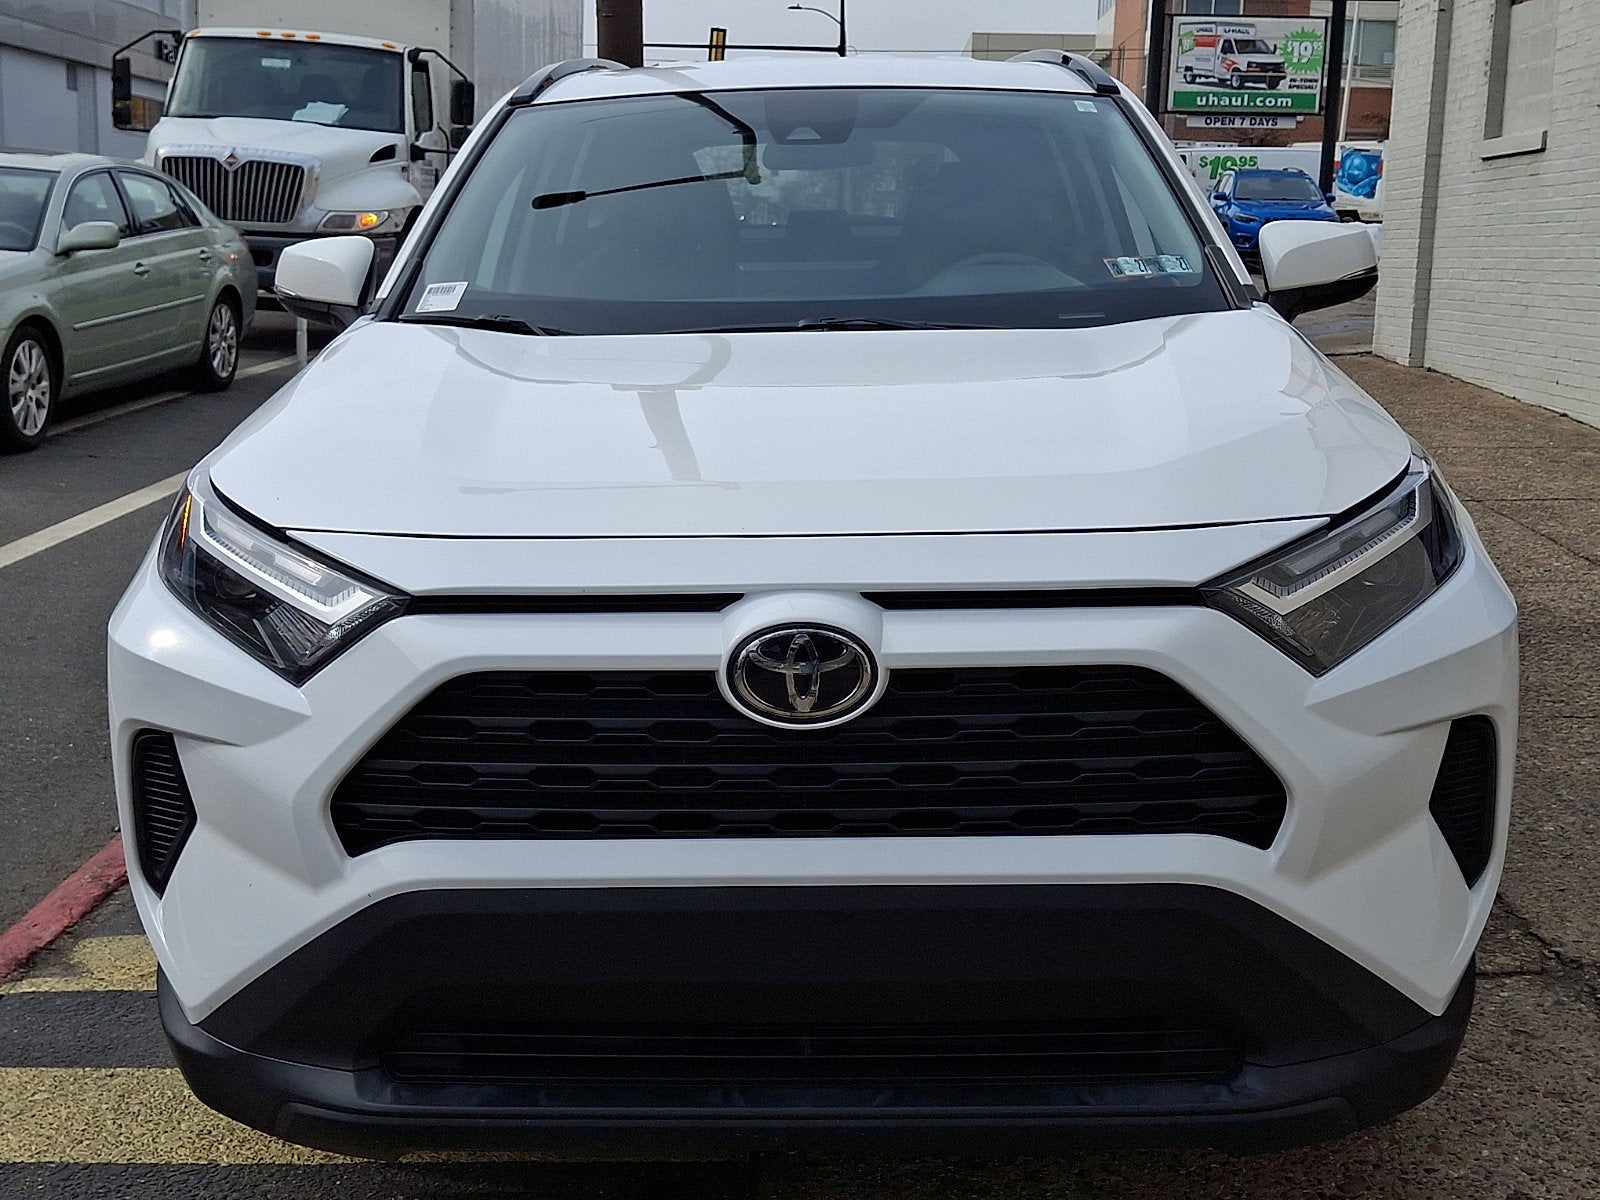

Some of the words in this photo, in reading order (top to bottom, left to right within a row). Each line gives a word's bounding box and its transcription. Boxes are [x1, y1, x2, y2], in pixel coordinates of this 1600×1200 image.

[1196, 93, 1293, 108] uhaul.com
[1204, 116, 1236, 126] OPEN
[1240, 117, 1247, 126] 7
[1249, 117, 1279, 127] DAYS
